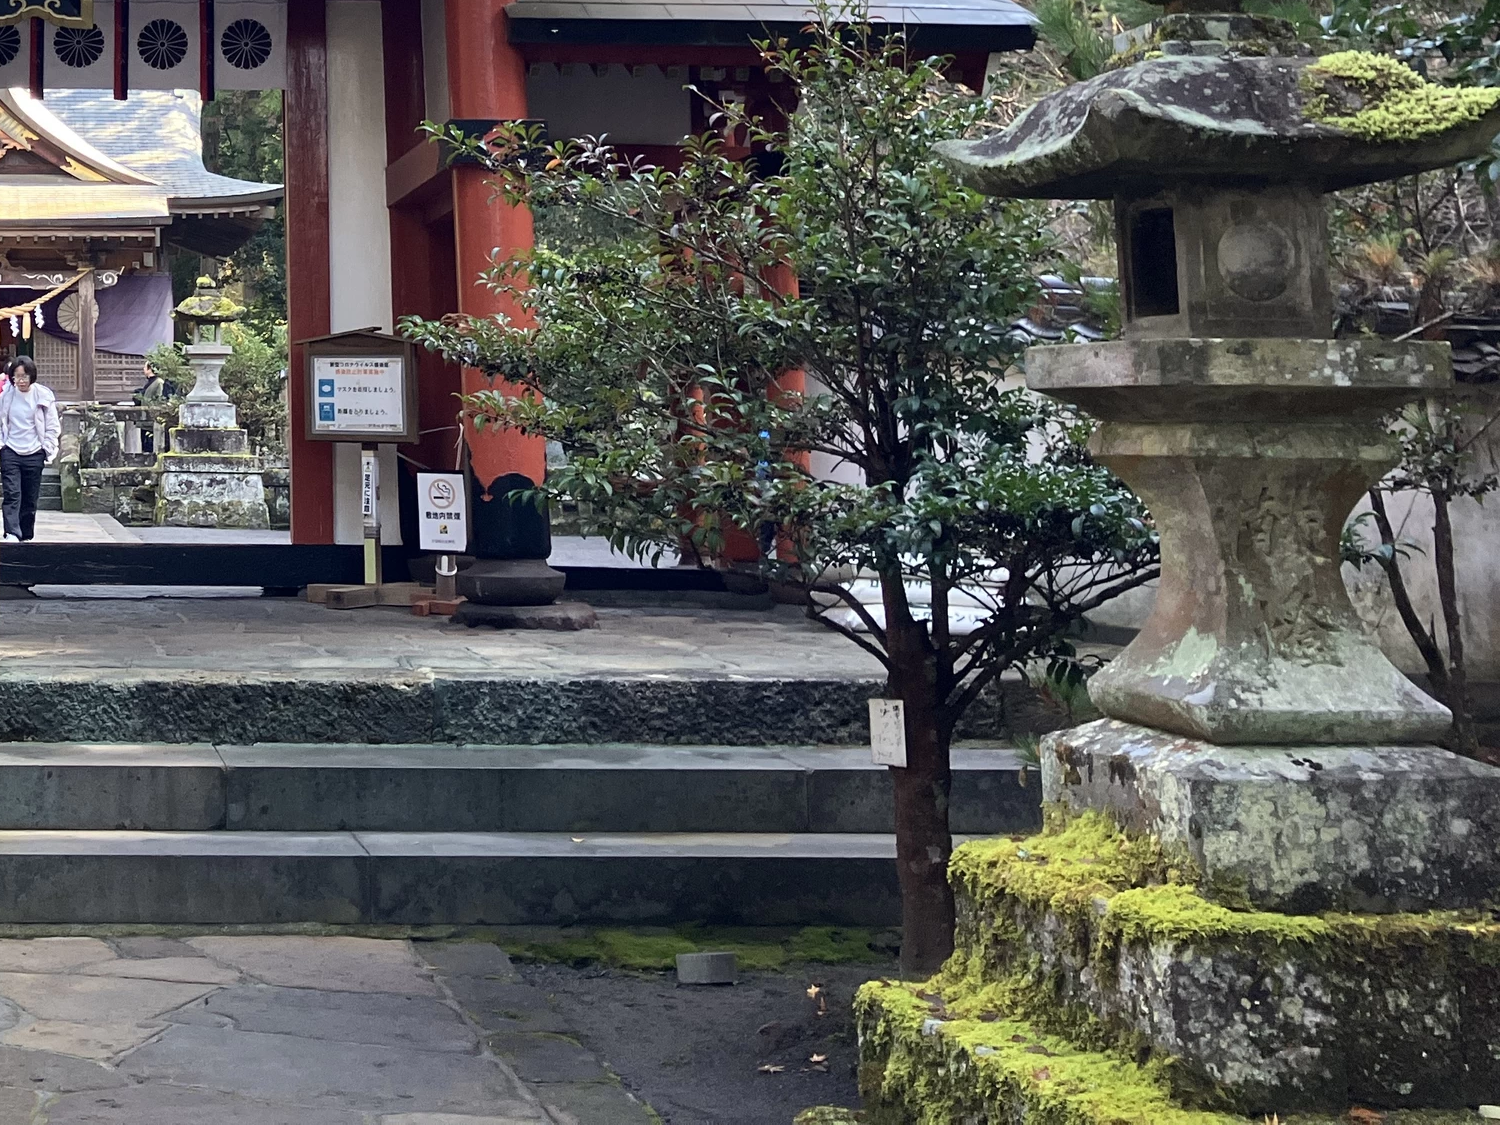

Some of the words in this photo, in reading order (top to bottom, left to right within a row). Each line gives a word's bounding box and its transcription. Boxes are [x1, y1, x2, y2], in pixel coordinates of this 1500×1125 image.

[425, 511, 461, 521] 敷地内禁煙
